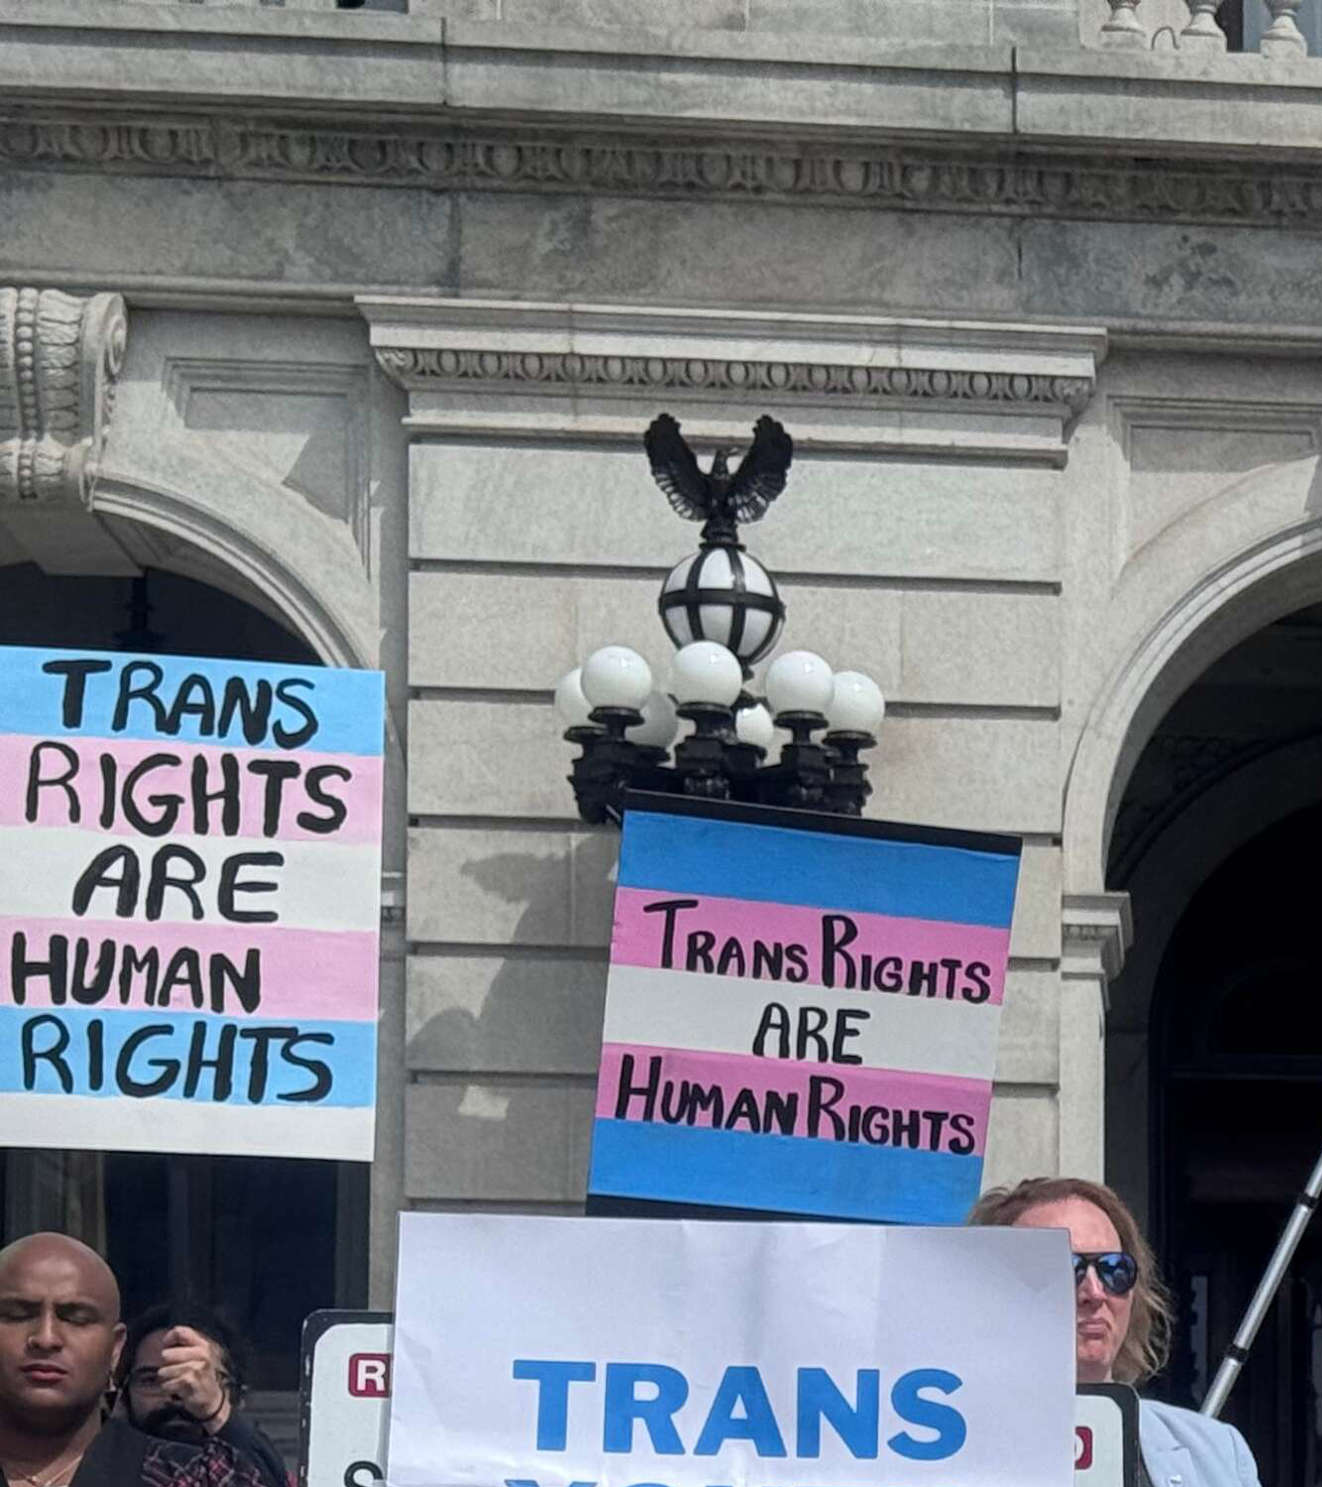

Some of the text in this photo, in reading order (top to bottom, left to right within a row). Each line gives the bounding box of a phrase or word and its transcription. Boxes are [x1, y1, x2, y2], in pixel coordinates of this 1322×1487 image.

[43, 657, 320, 748] TRANS
[24, 741, 353, 837] RIGHTS
[72, 844, 284, 924] ARE
[11, 931, 262, 1011] HUMAN
[642, 898, 995, 1005] TRANS RIGHTS
[20, 1013, 336, 1104] RIGHTS
[752, 1001, 866, 1066] ARE
[613, 1055, 978, 1155] HUMAN RIGHTS
[512, 1359, 968, 1461] TRANS
